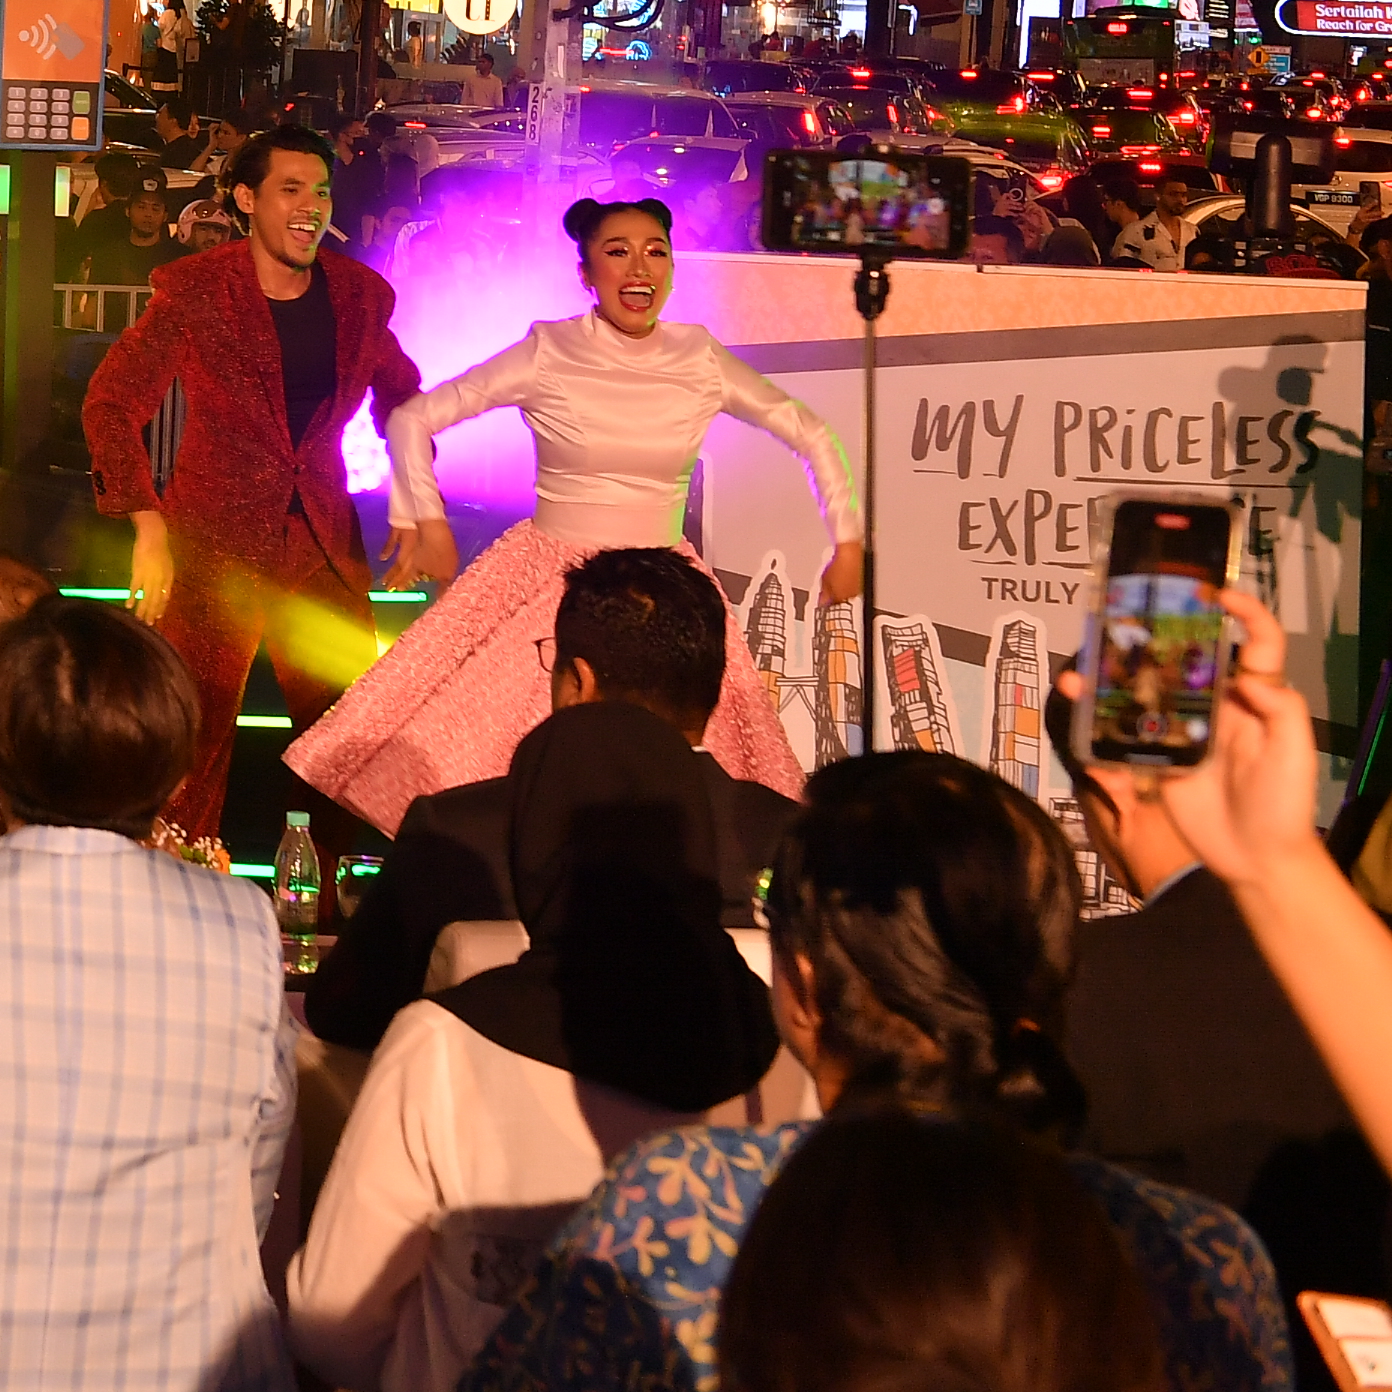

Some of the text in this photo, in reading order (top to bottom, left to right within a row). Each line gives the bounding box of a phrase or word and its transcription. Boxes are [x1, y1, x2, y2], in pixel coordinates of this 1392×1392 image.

[1315, 3, 1382, 19] Sertailah
[1317, 19, 1373, 31] Reach for
[910, 393, 1025, 481] MY
[981, 576, 1081, 605] TRULY
